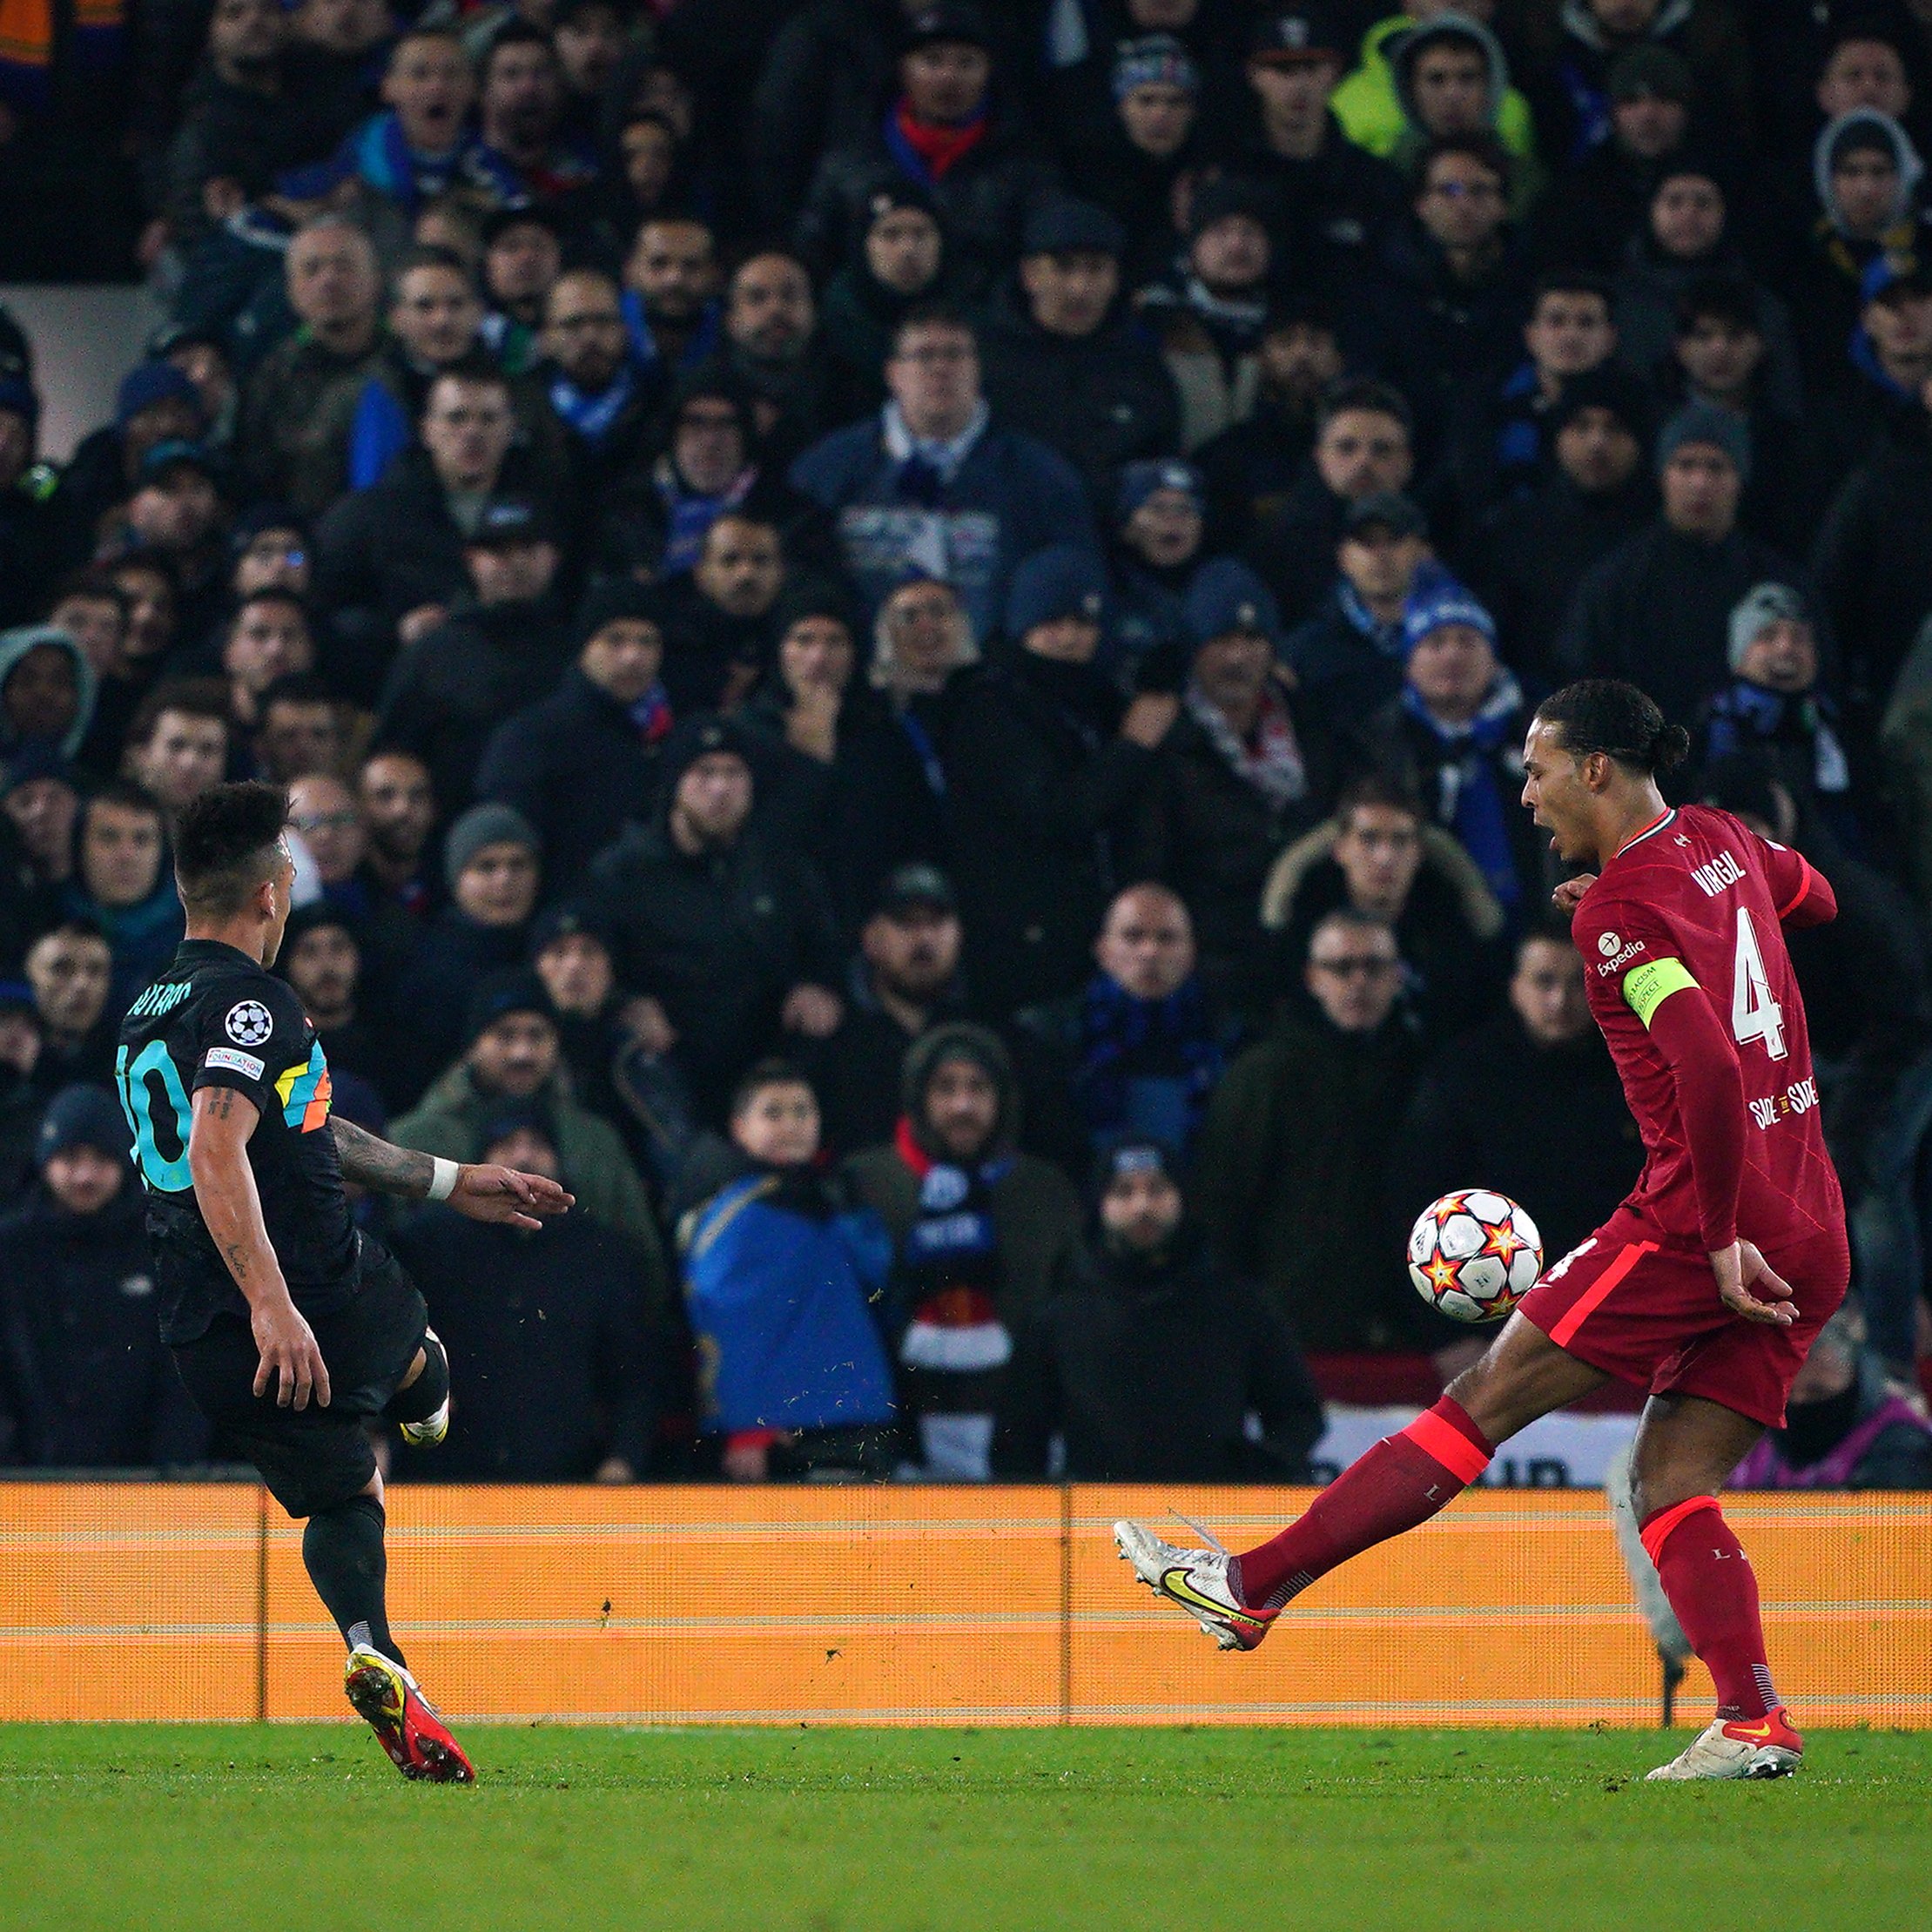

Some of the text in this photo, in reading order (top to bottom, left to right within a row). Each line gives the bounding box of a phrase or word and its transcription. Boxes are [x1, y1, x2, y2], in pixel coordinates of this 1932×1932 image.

[1690, 850, 1747, 897] VIRGIL
[1597, 940, 1646, 977] Expedia
[1732, 906, 1788, 1061] 4
[1748, 1095, 1781, 1130] SIDE
[1787, 1076, 1820, 1114] SIDE
